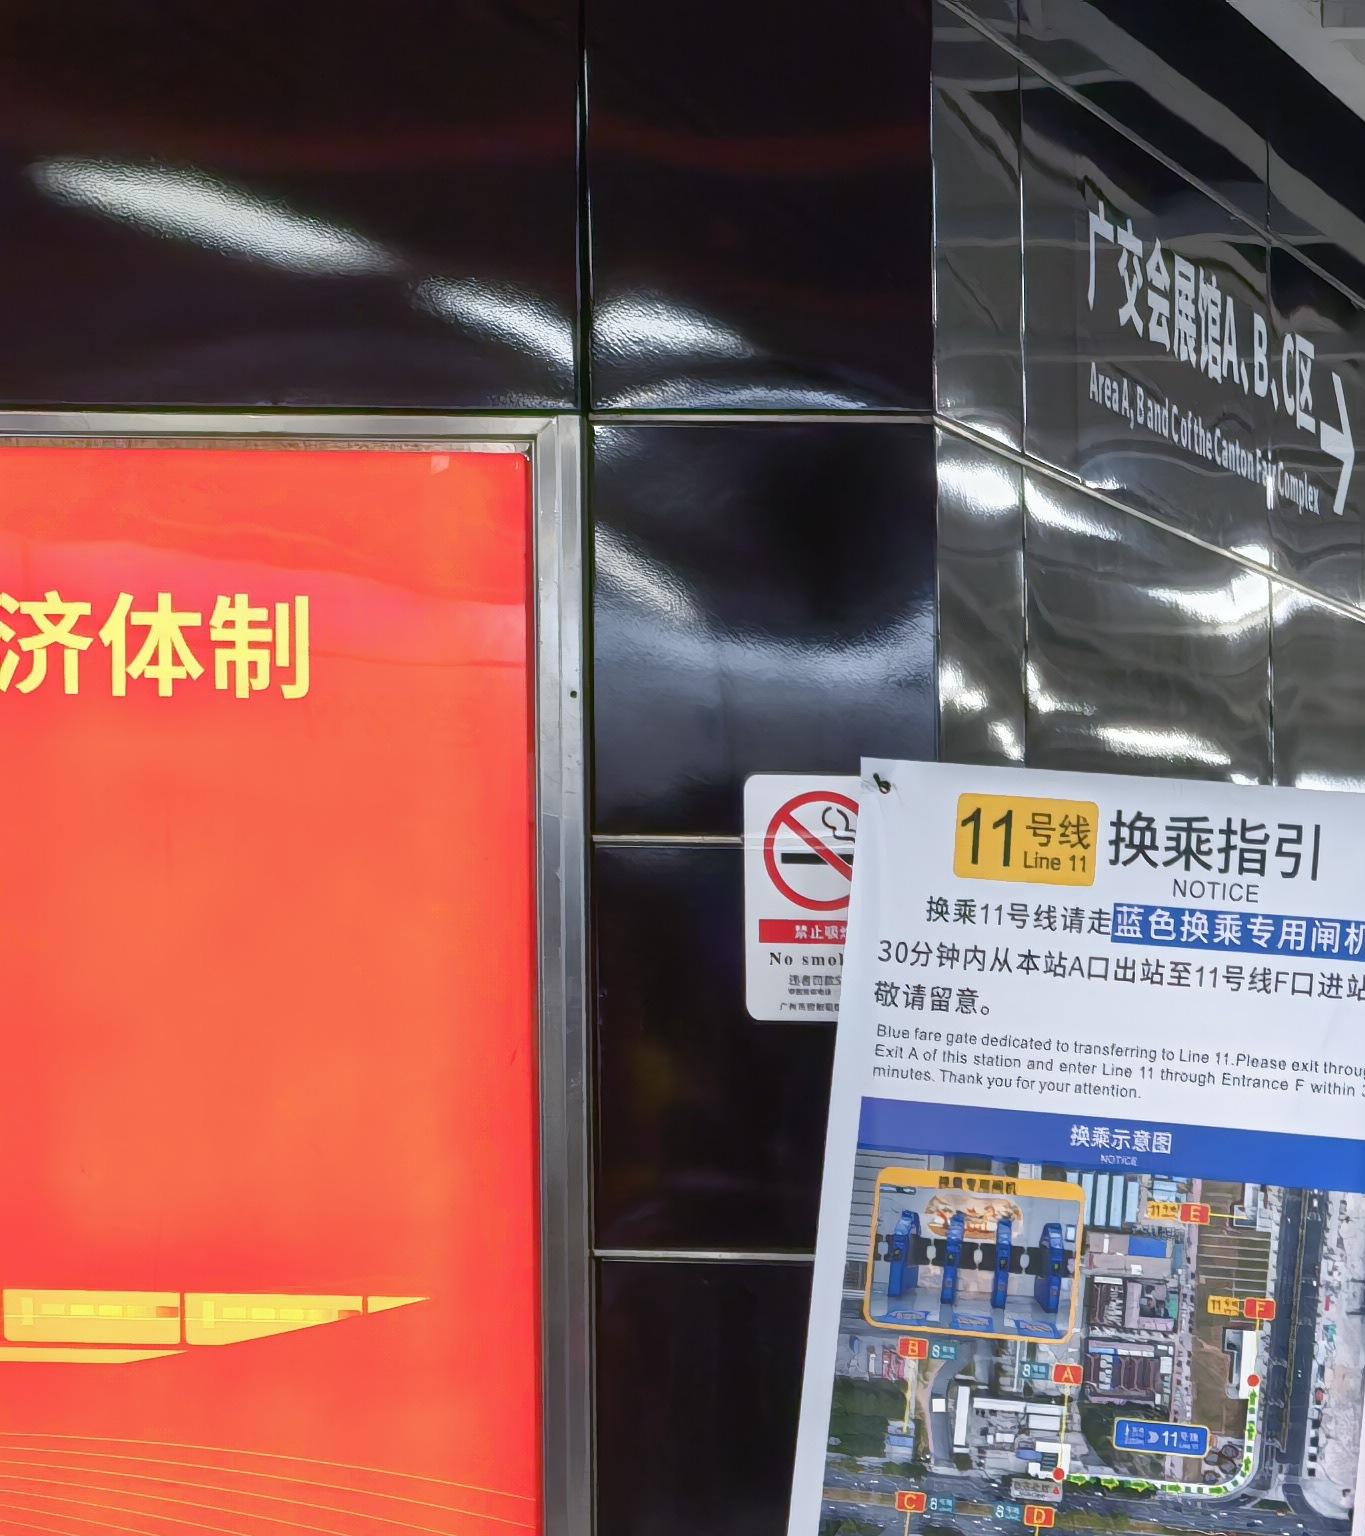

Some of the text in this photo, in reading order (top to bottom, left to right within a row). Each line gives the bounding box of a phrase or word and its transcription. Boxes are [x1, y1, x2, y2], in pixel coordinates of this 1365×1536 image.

[1089, 361, 1120, 413] Area
[1136, 385, 1145, 425] B
[1147, 398, 1170, 438] and
[1171, 404, 1180, 447] C
[1181, 411, 1193, 452] of
[1193, 419, 1213, 461] the
[1214, 428, 1254, 480] Canton
[1278, 462, 1320, 515] Complex
[0, 590, 311, 701] 济体制
[960, 807, 1014, 868] 11
[1025, 812, 1091, 850] 号线
[1107, 808, 1322, 882] 换乘指引
[1023, 850, 1088, 873] Line 11
[1172, 878, 1261, 904] NOTICE
[769, 951, 793, 967] No
[873, 980, 991, 1016] 敬请留意。
[876, 1023, 909, 1039] Blue
[914, 1027, 941, 1041] fare
[946, 1032, 977, 1045] gate
[980, 1032, 1052, 1050] dedicated
[1056, 1039, 1069, 1052] to
[1073, 1040, 1156, 1061] transferring
[1161, 1047, 1174, 1061] to
[1179, 1048, 1209, 1063] Line
[1291, 1059, 1319, 1073] exit
[872, 1065, 1141, 1098] minutes. Thank you for your attention.
[874, 1043, 903, 1059] Exit
[922, 1048, 937, 1061] of
[942, 1049, 967, 1064] this
[972, 1052, 1021, 1068] station
[1026, 1058, 1053, 1071] and
[1059, 1061, 1097, 1074] enter
[1102, 1062, 1132, 1078] Line
[1139, 1065, 1152, 1079] 11
[1160, 1067, 1215, 1086] through
[1221, 1071, 1288, 1090] Entrance
[1310, 1081, 1355, 1096] within
[1070, 1123, 1173, 1155] 换乘示意图
[1190, 1206, 1200, 1221] E
[1256, 1301, 1266, 1317] F
[908, 1340, 919, 1354] B
[1061, 1368, 1074, 1383] A
[904, 1495, 916, 1509] C
[1033, 1508, 1045, 1524] D
